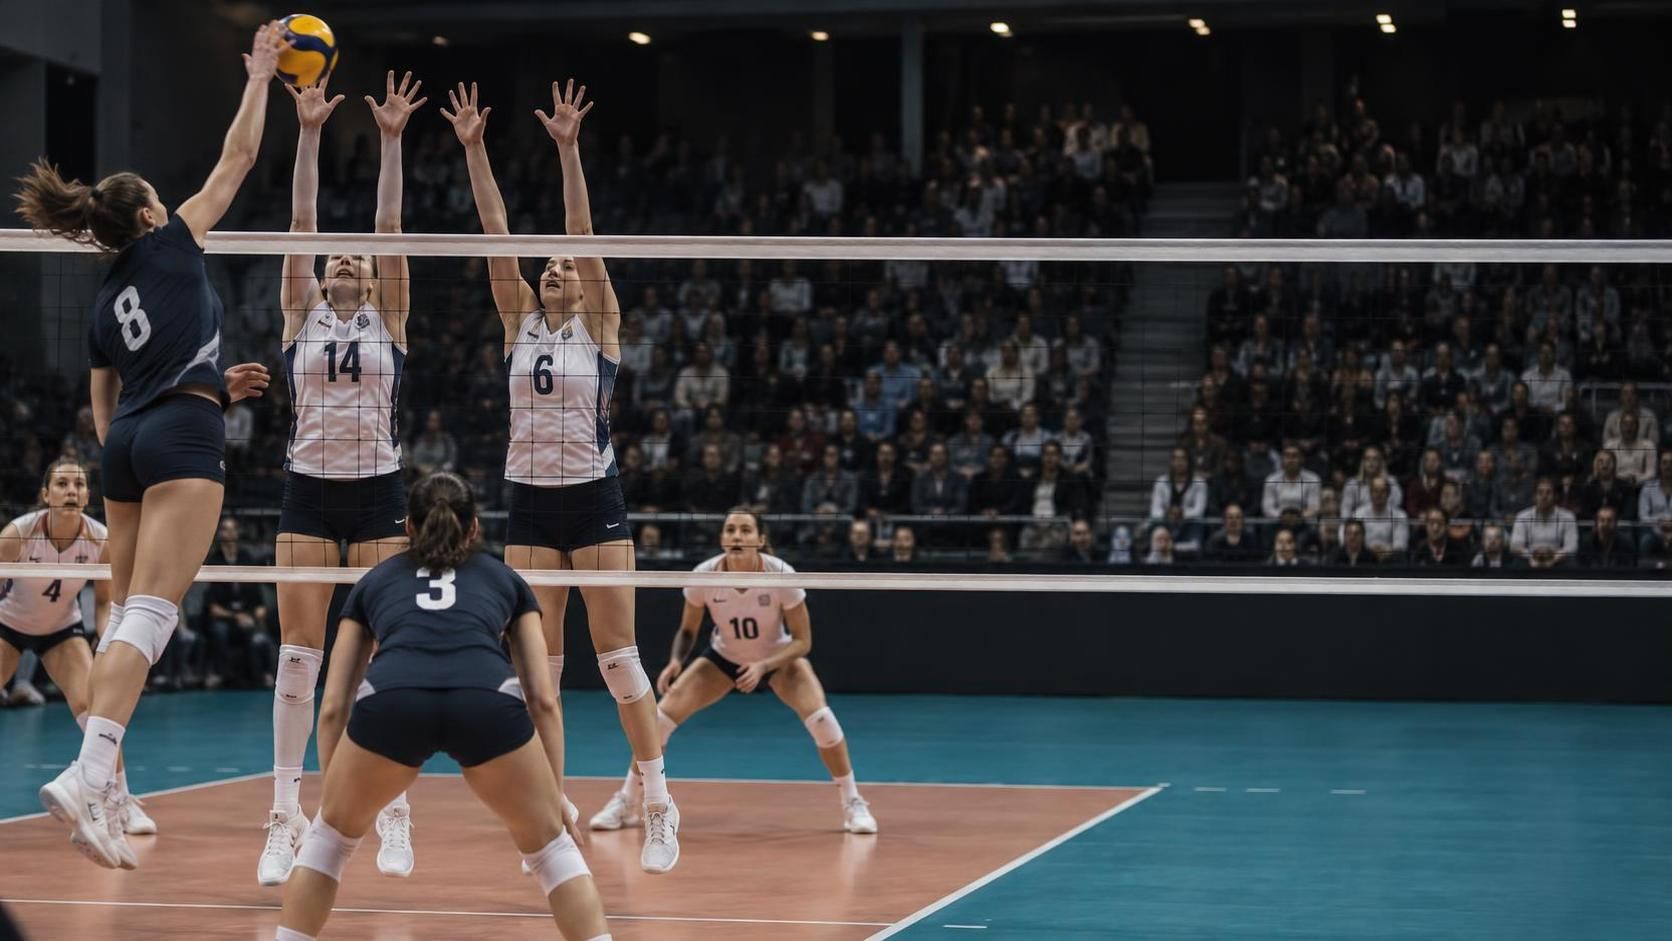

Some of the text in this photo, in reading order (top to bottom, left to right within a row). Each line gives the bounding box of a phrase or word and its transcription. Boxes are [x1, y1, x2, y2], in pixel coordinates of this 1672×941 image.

[113, 286, 151, 351] 8
[324, 341, 361, 381] 14
[533, 354, 553, 395] 6
[42, 580, 61, 602] 4
[416, 568, 456, 610] 3
[730, 617, 759, 640] 10
